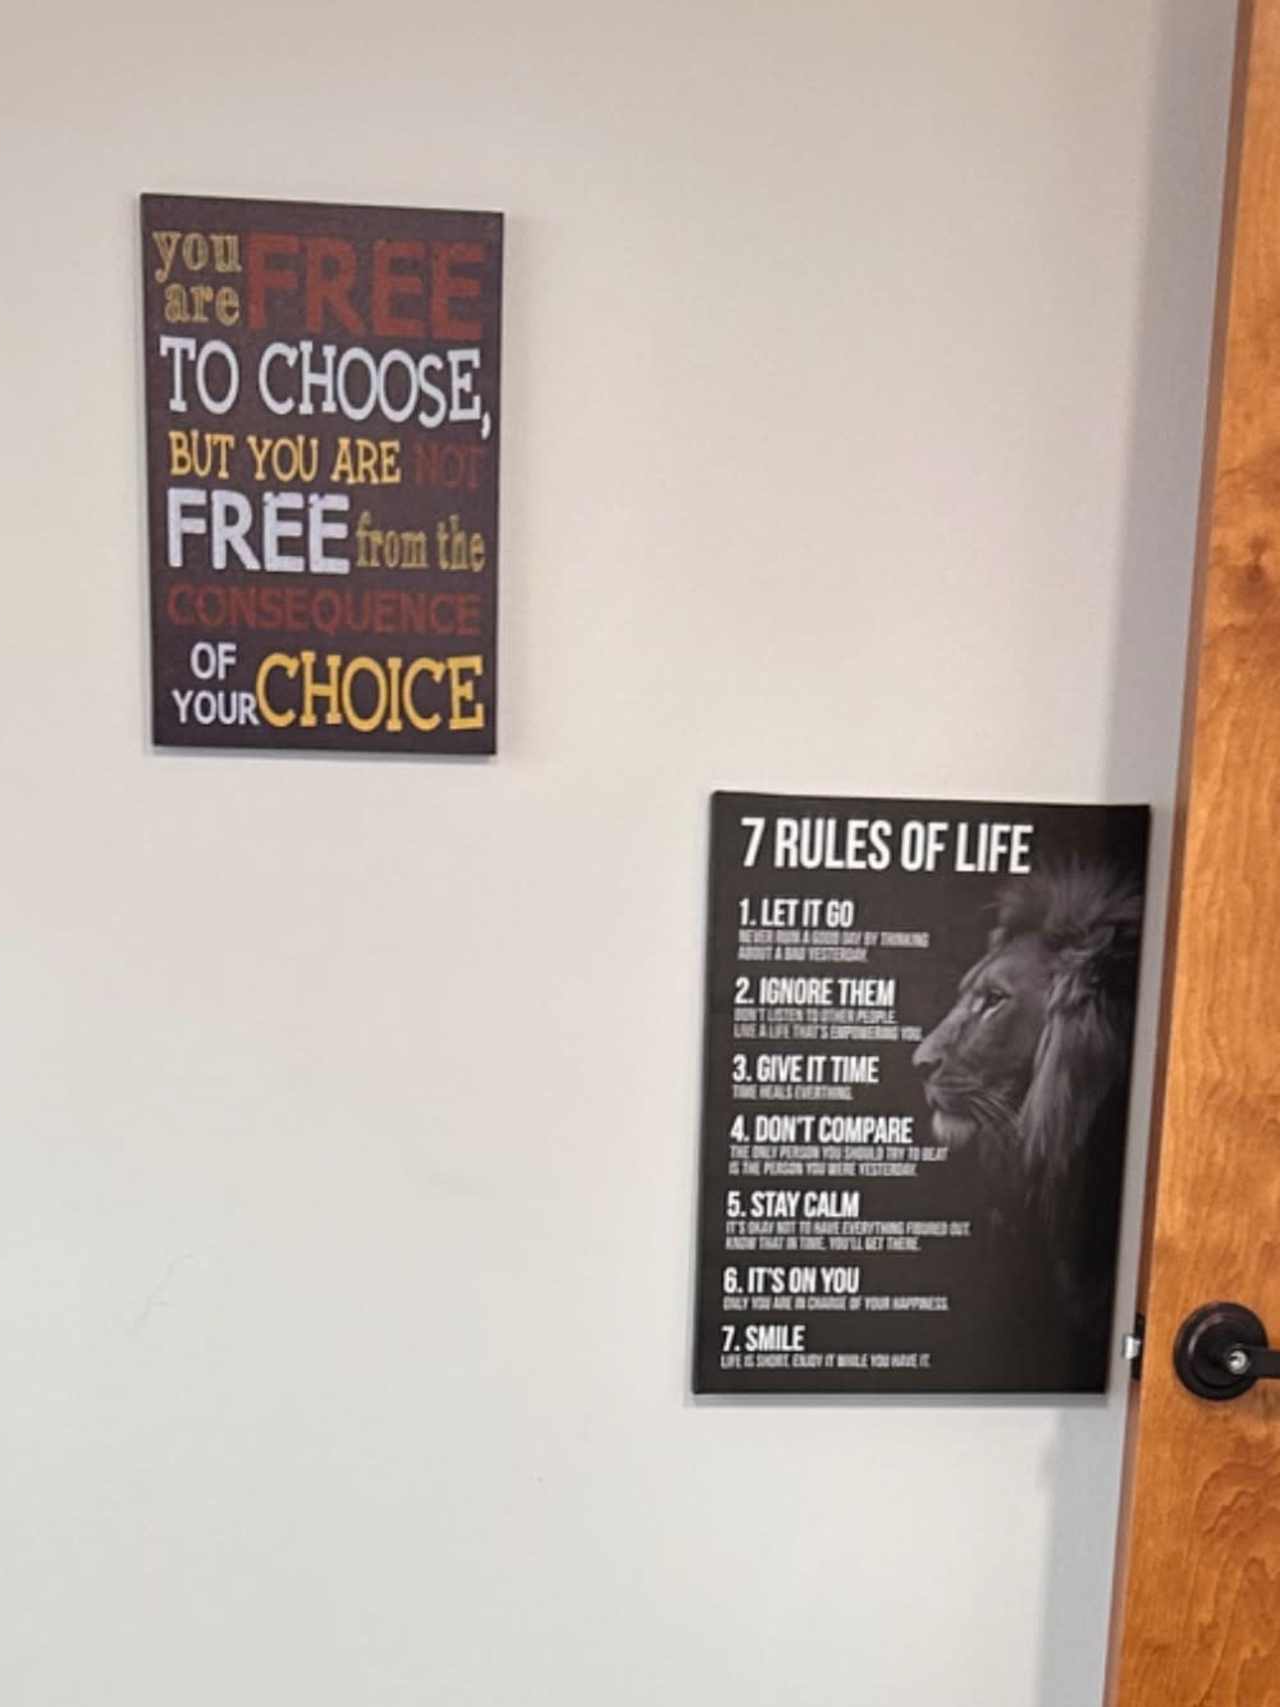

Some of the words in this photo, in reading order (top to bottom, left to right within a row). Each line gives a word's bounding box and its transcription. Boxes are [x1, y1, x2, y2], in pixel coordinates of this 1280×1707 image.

[153, 228, 242, 282] you
[164, 281, 241, 326] are
[244, 228, 489, 341] FREE
[159, 334, 240, 414] TO
[258, 339, 491, 439] CHOOSE,
[169, 430, 235, 477] BUT
[247, 434, 319, 483] YOU
[331, 437, 401, 484] ARE
[414, 444, 484, 489] NOT
[166, 488, 351, 575] FREE
[356, 511, 428, 571] from
[438, 514, 487, 572] the
[167, 583, 482, 636] CONSEQUENCE
[190, 641, 237, 681] OF
[172, 689, 259, 726] YOUR
[255, 649, 485, 732] CHOICE
[741, 817, 765, 868] 7
[774, 818, 890, 870] RULES
[900, 820, 948, 872] OF
[955, 823, 1034, 874] LIFE
[739, 898, 756, 927] 1.
[761, 898, 799, 927] LET
[803, 899, 824, 927] IT
[825, 900, 855, 928] GO
[735, 977, 754, 1006] 2.
[759, 978, 832, 1007] IGNORE
[837, 979, 895, 1008] THEM
[733, 1054, 751, 1083] 3.
[756, 1054, 803, 1083] GIVE
[807, 1055, 829, 1083] IT
[830, 1056, 879, 1084] TIME
[730, 1115, 749, 1143] 4.
[755, 1115, 815, 1143] DON'T
[819, 1116, 914, 1144] COMPARE
[727, 1190, 746, 1217] 5.
[751, 1191, 801, 1218] STAY
[804, 1191, 860, 1218] CALM
[723, 1266, 743, 1293] 6.
[748, 1266, 785, 1294] IT'S
[789, 1267, 816, 1294] ON
[820, 1267, 860, 1294] YOU
[721, 1325, 740, 1352] 7.
[745, 1325, 805, 1352] SMILE
